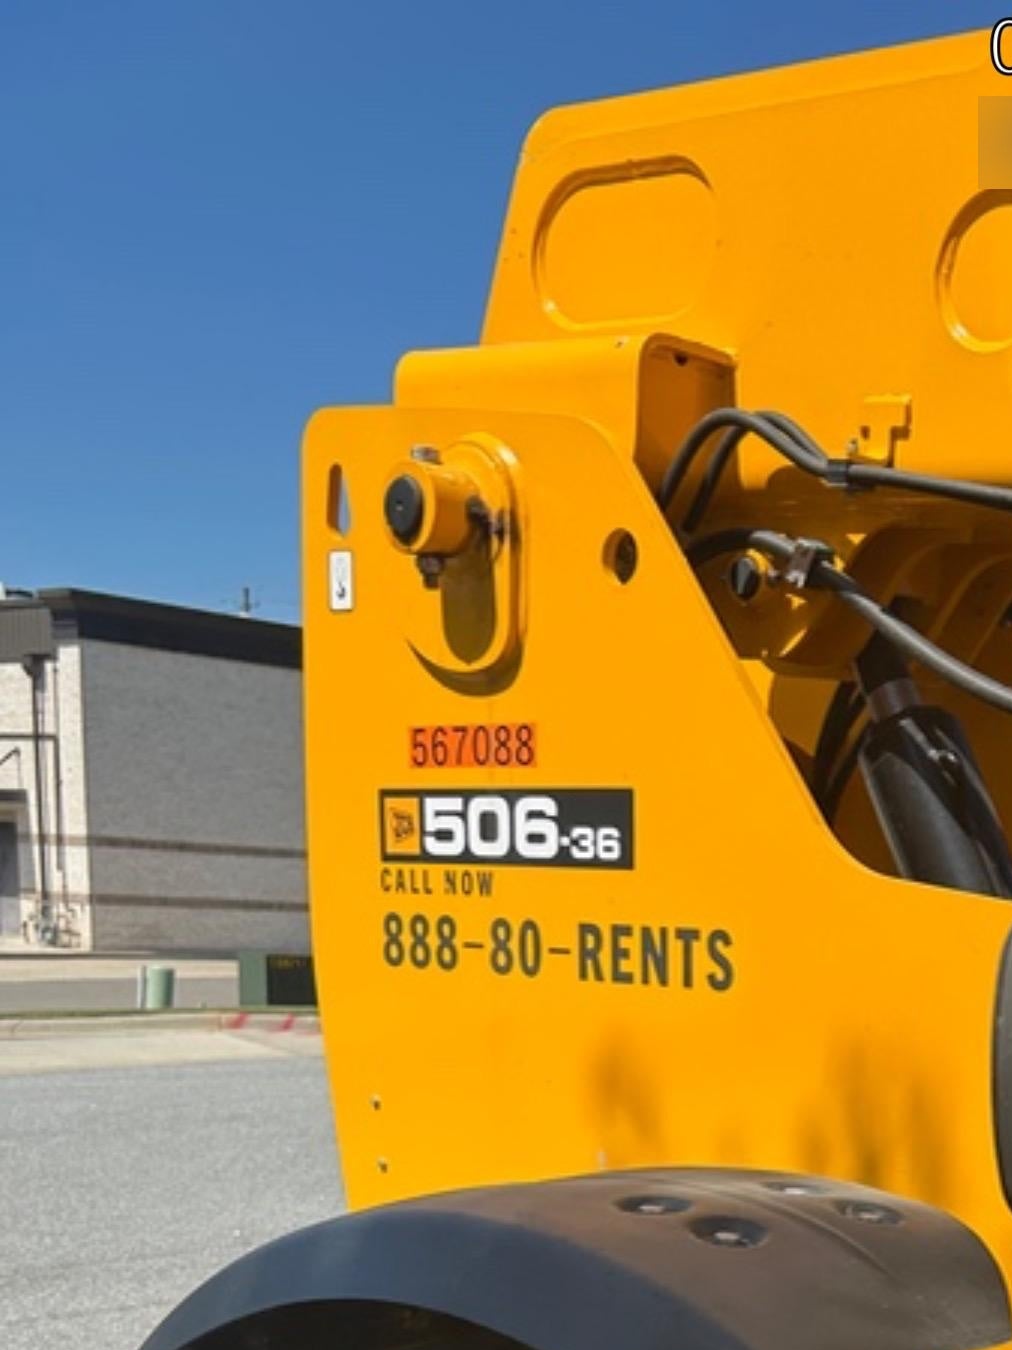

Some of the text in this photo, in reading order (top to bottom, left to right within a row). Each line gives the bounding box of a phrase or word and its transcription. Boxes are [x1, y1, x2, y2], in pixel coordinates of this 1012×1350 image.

[411, 723, 536, 768] 567088
[380, 866, 494, 897] CALL NOW
[382, 911, 735, 993] 888-80-RENTS
